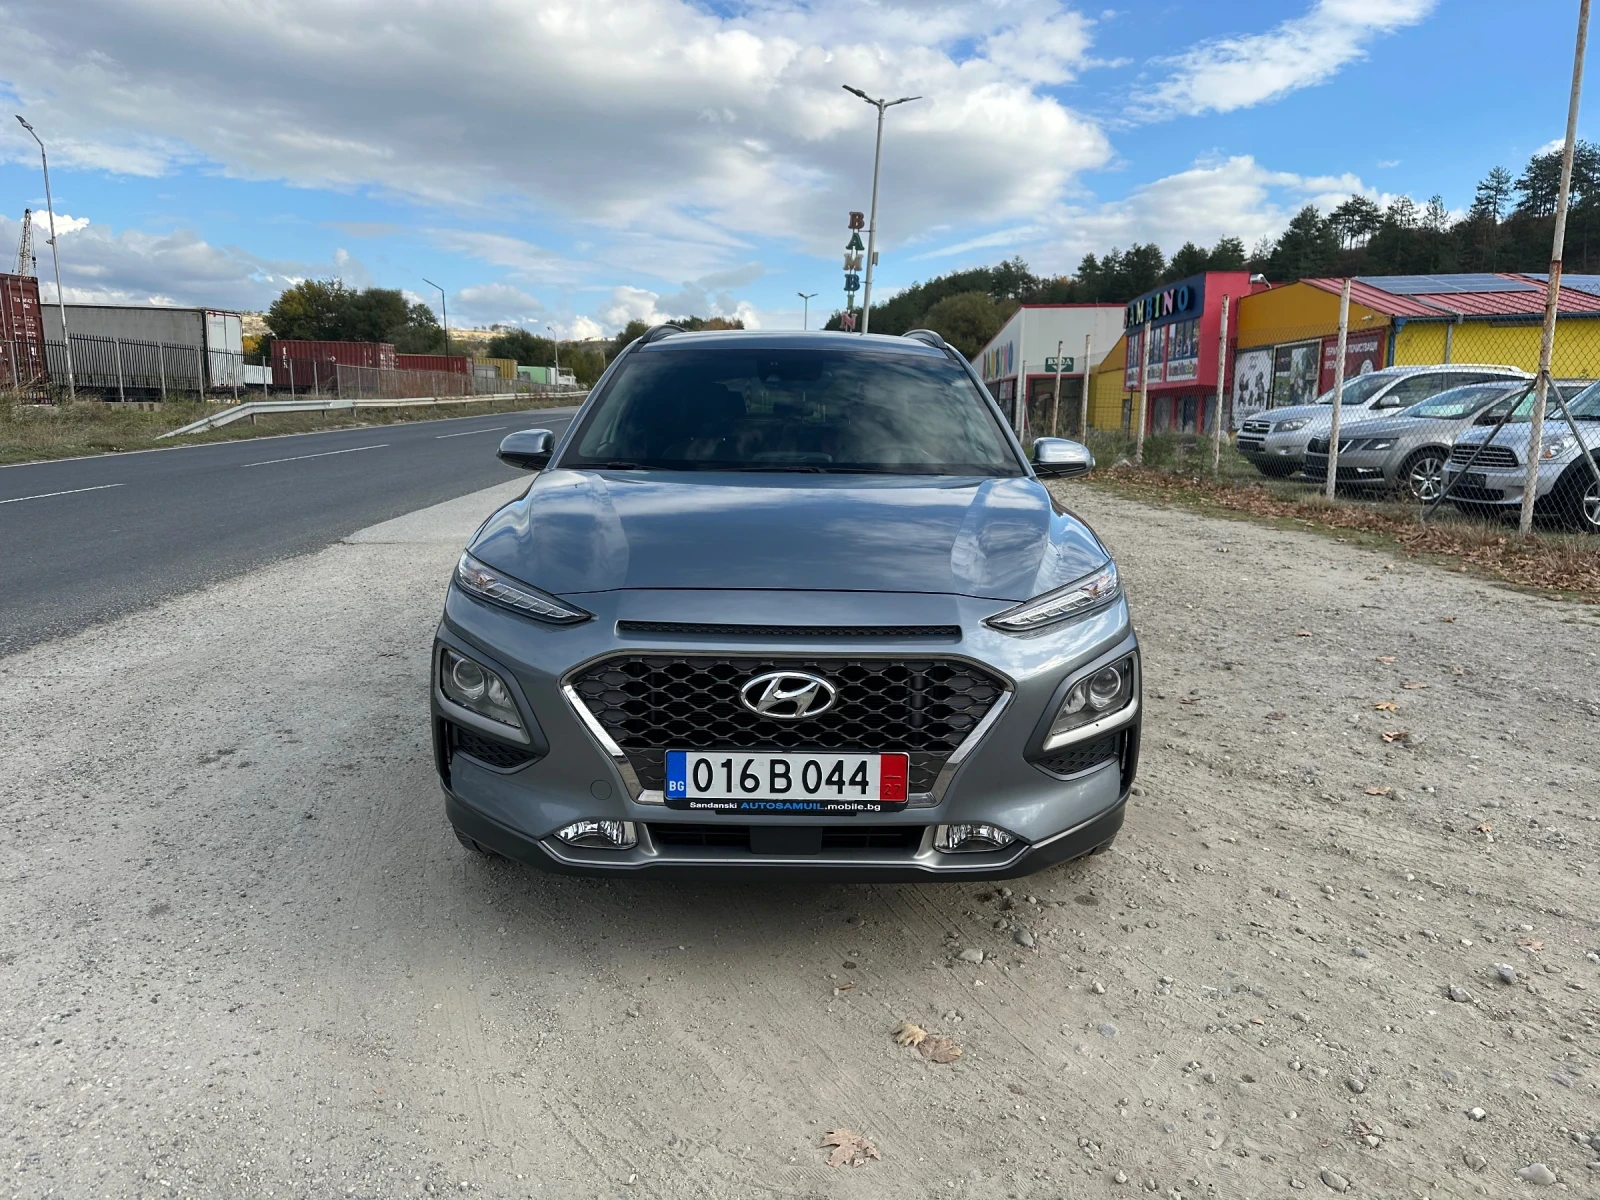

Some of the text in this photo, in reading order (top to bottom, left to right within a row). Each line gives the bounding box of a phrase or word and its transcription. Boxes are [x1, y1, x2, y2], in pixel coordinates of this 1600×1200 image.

[1123, 285, 1189, 329] BAMBINO
[669, 780, 685, 791] BG
[689, 801, 738, 809] Sandanski
